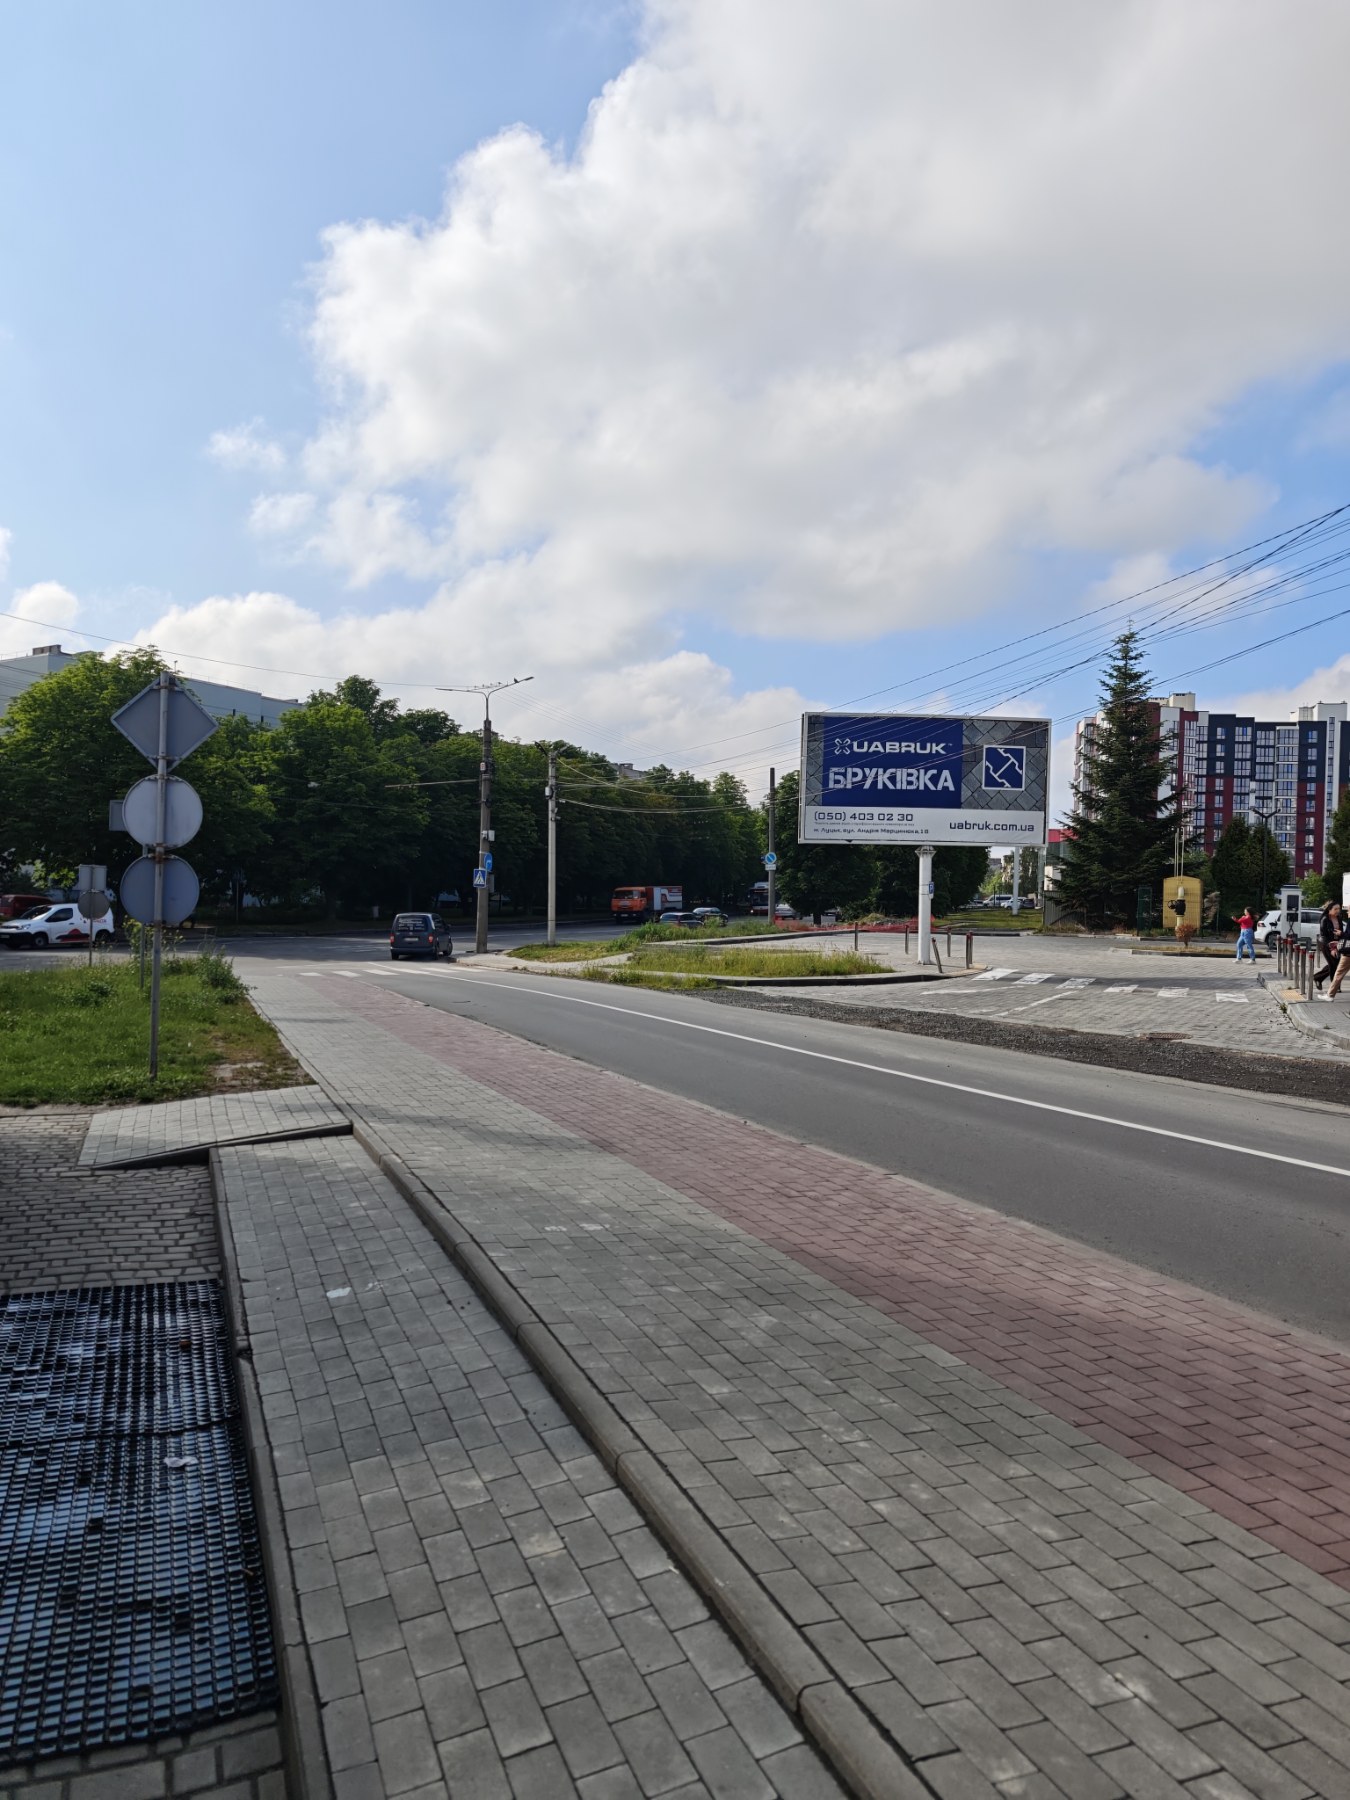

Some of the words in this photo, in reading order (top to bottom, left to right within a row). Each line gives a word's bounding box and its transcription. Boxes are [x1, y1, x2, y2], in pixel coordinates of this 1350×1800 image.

[853, 741, 947, 754] UABRUK
[829, 767, 955, 791] БРУКІВКА
[814, 811, 846, 821] (050)
[850, 812, 874, 821] 403
[878, 813, 893, 821] 02
[897, 813, 913, 822] 30
[949, 820, 1034, 832] uabruk.com.ua
